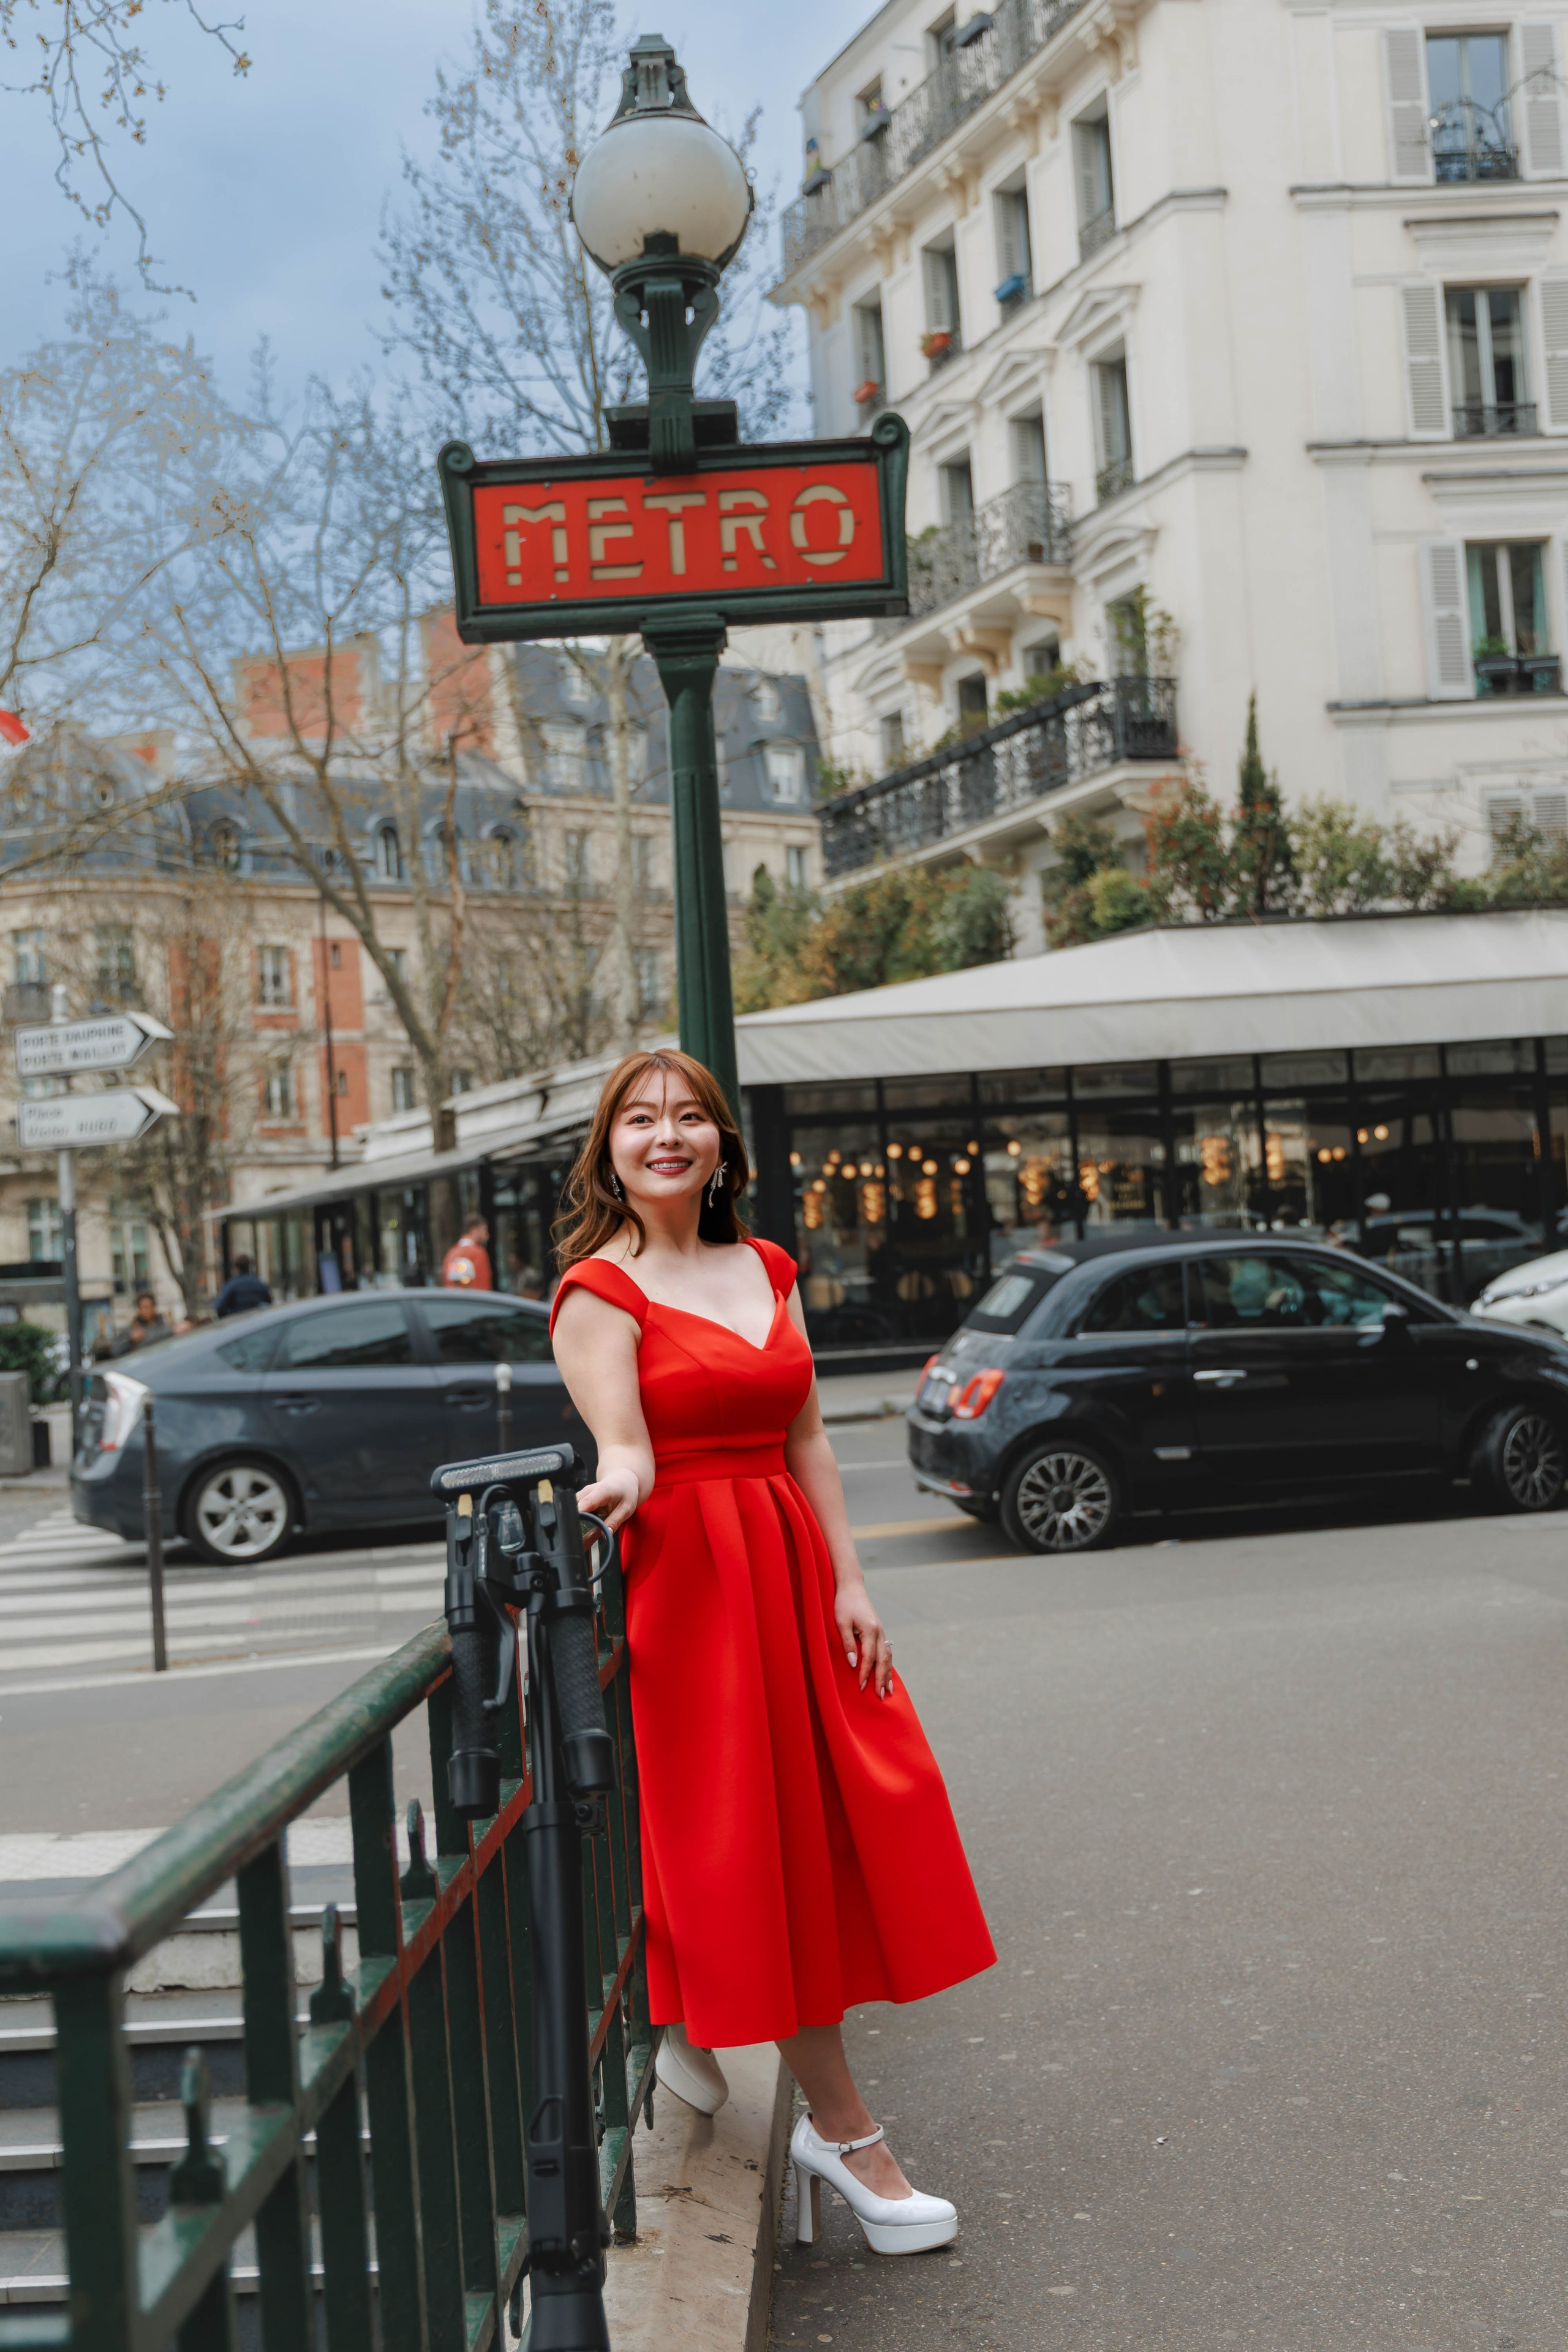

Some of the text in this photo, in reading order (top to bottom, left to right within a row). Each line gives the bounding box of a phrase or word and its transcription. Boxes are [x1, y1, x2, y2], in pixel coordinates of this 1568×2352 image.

[502, 484, 855, 586] METRO
[23, 1033, 59, 1047] PORTE
[24, 1052, 62, 1066] PORTE
